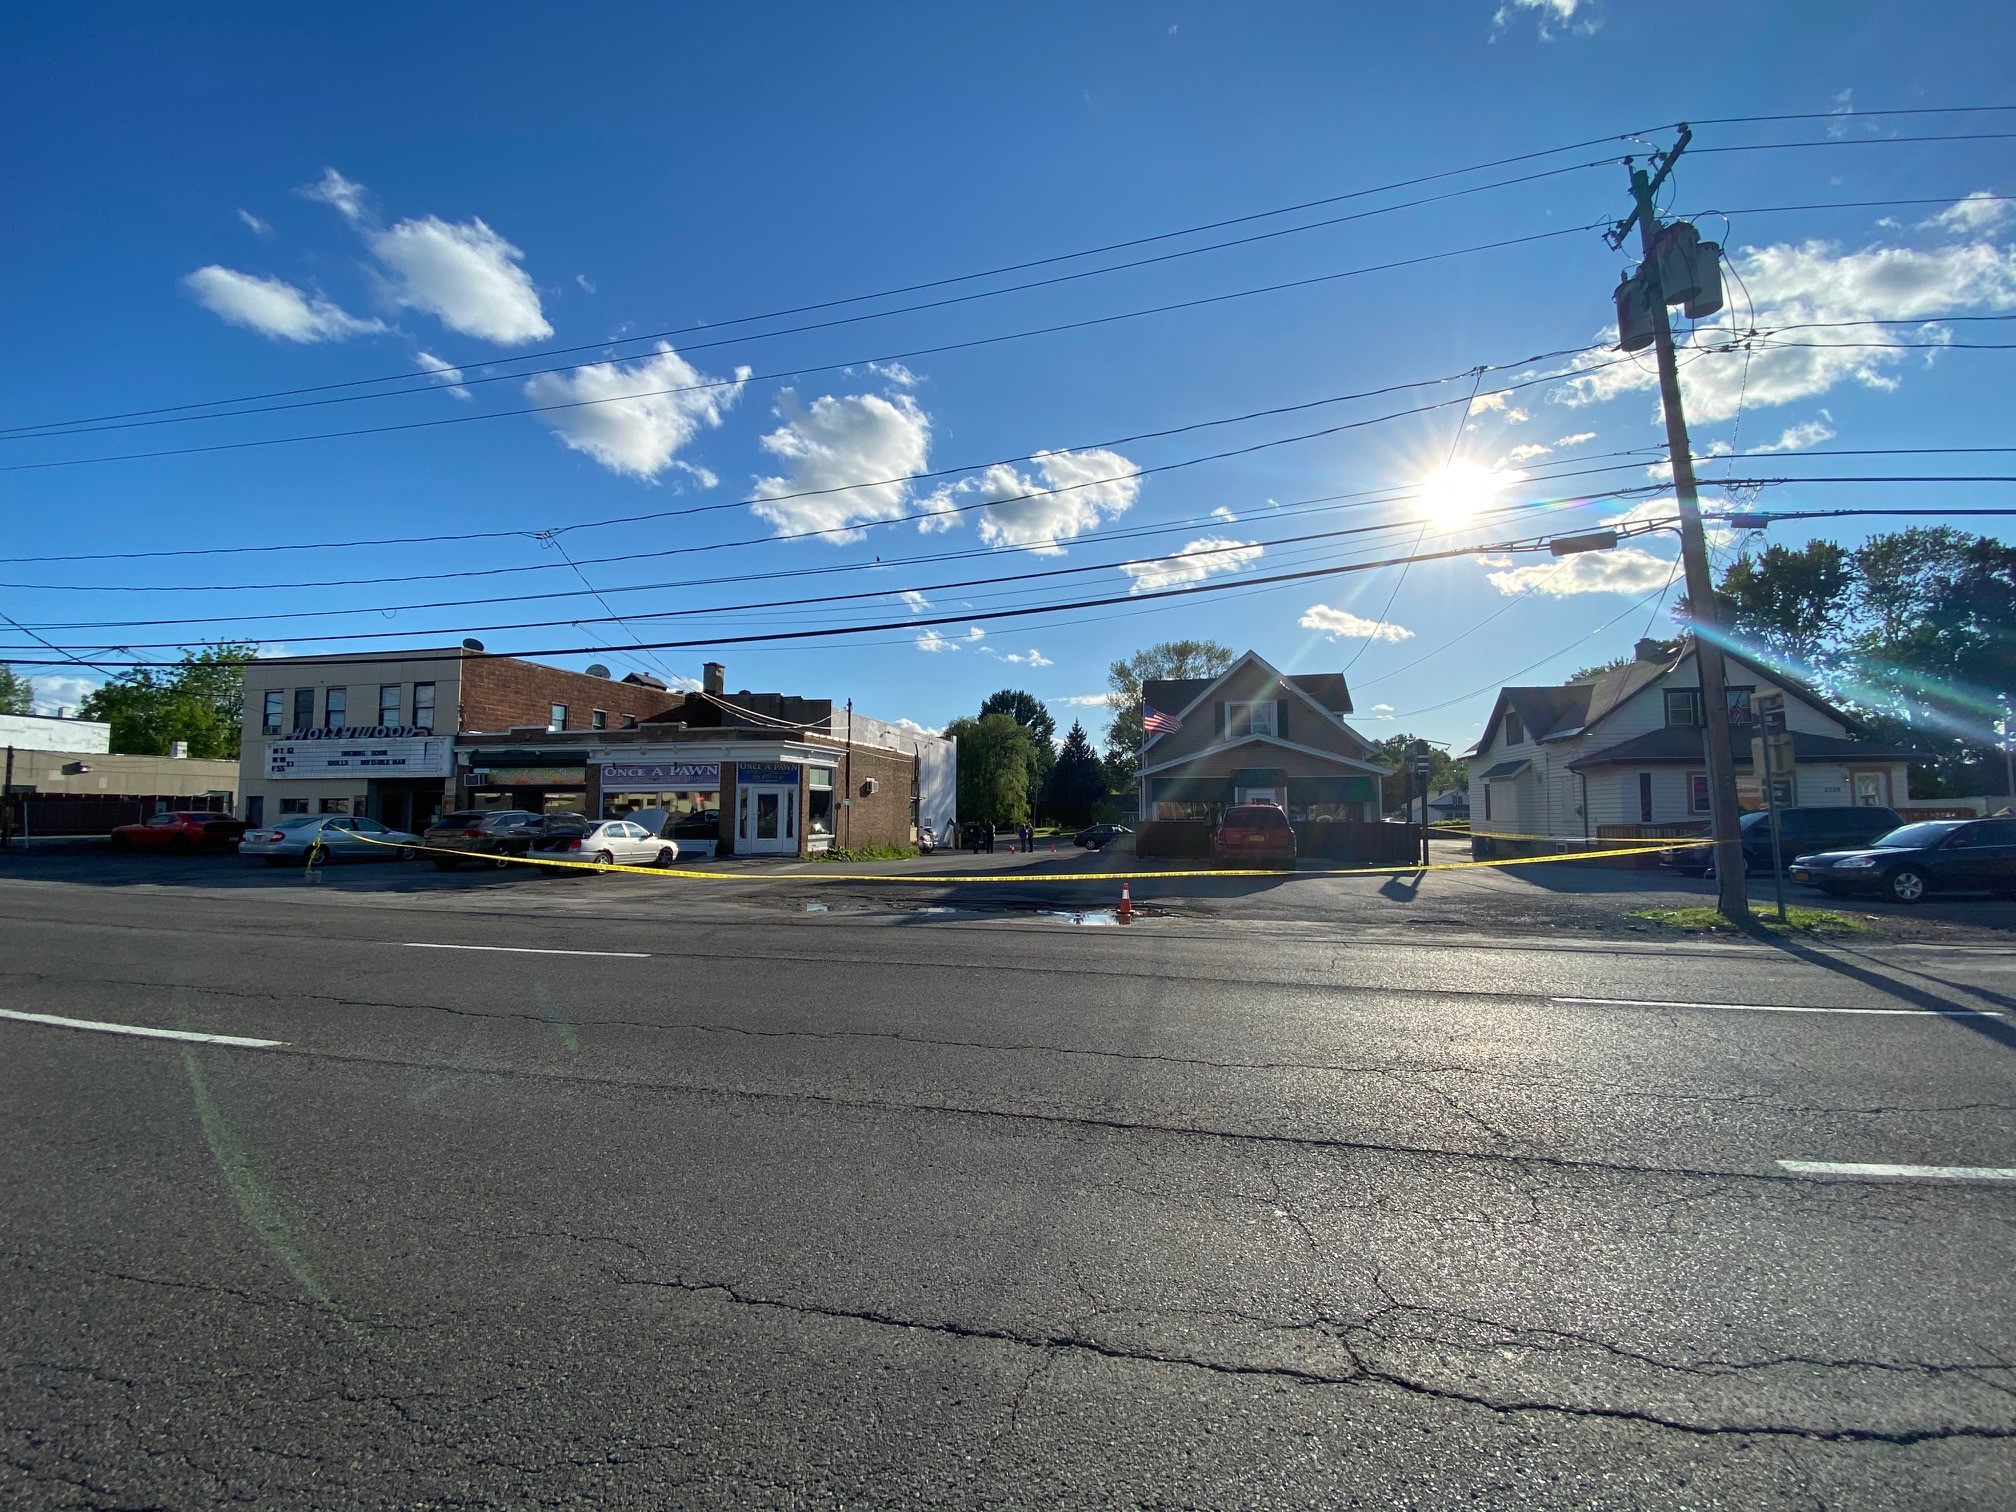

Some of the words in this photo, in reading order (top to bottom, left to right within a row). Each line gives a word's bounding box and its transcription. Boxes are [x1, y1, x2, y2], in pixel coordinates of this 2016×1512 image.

[292, 725, 416, 741] HOLLYWOOD
[604, 766, 646, 777] ONCE
[652, 766, 663, 776] A
[670, 765, 719, 776] PAWN
[740, 762, 762, 770] ONCE
[774, 763, 798, 771] PAWN
